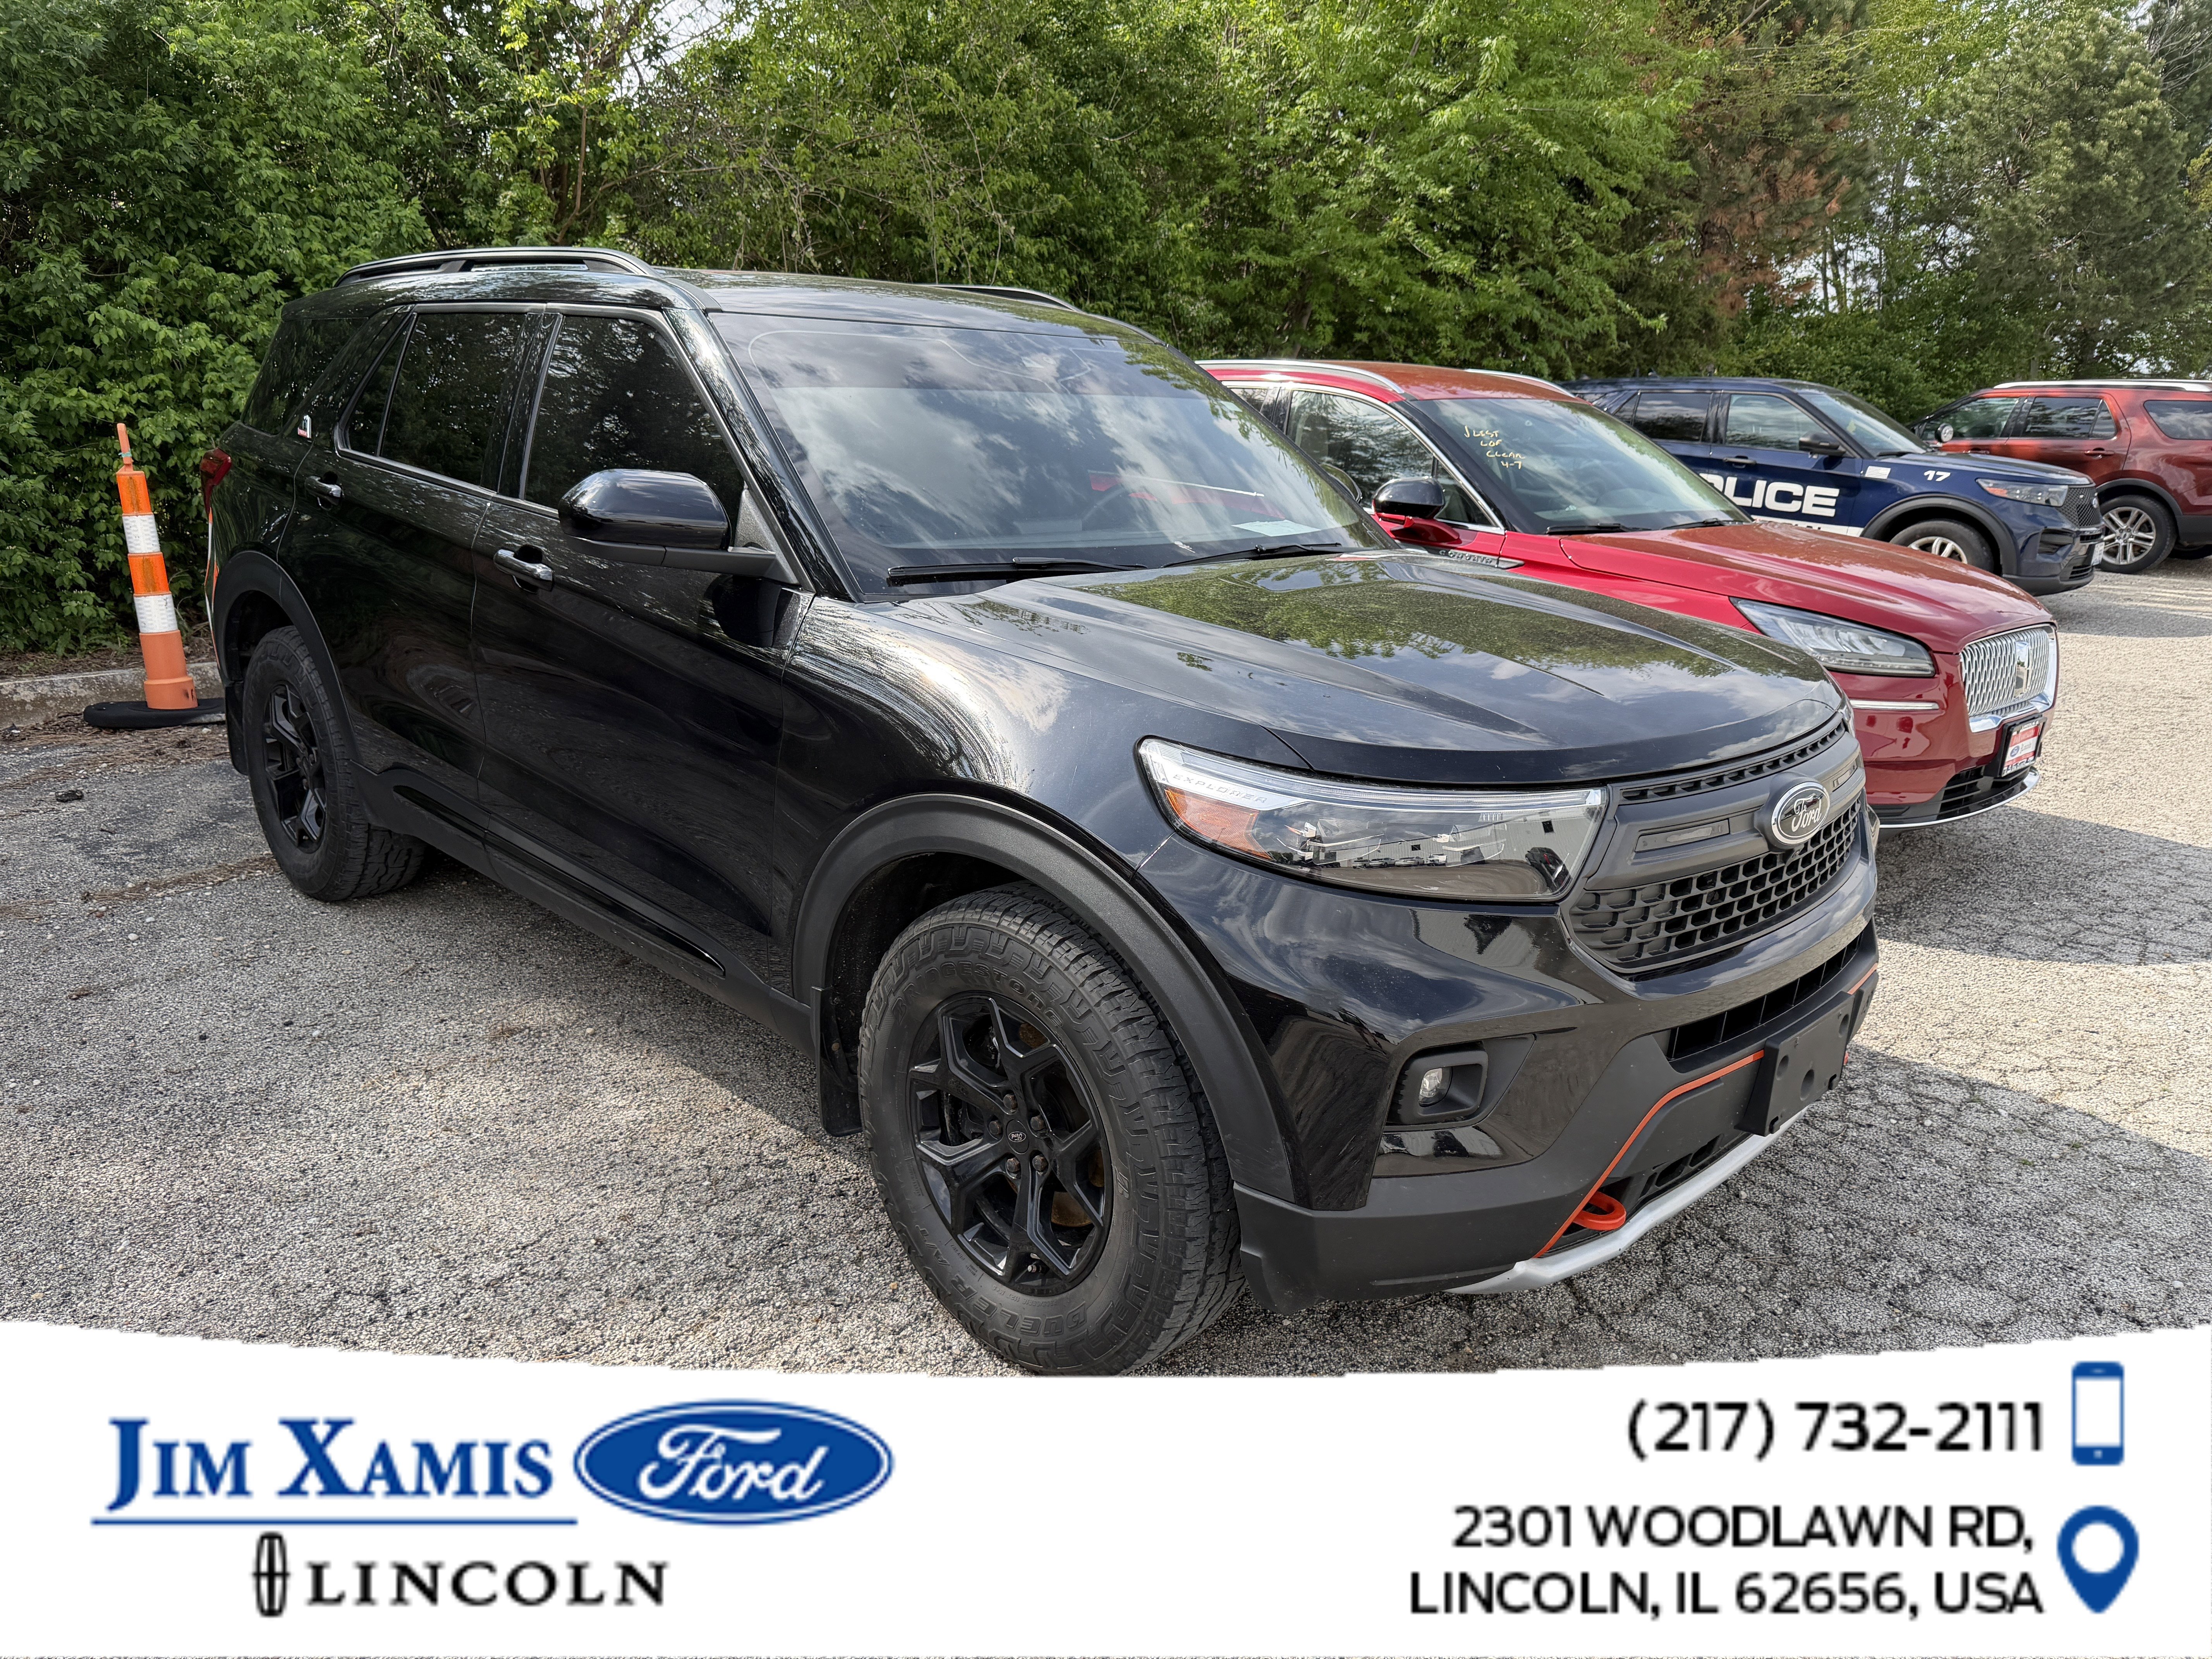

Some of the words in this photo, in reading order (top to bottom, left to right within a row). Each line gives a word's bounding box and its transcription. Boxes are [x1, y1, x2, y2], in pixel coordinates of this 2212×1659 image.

[1501, 460, 1522, 469] 4-7
[1923, 470, 1951, 481] 17
[1699, 473, 1839, 517] LICE
[1173, 774, 1267, 804] EXPLORER
[1791, 793, 1822, 832] Ford
[950, 1274, 1087, 1337] DUELER
